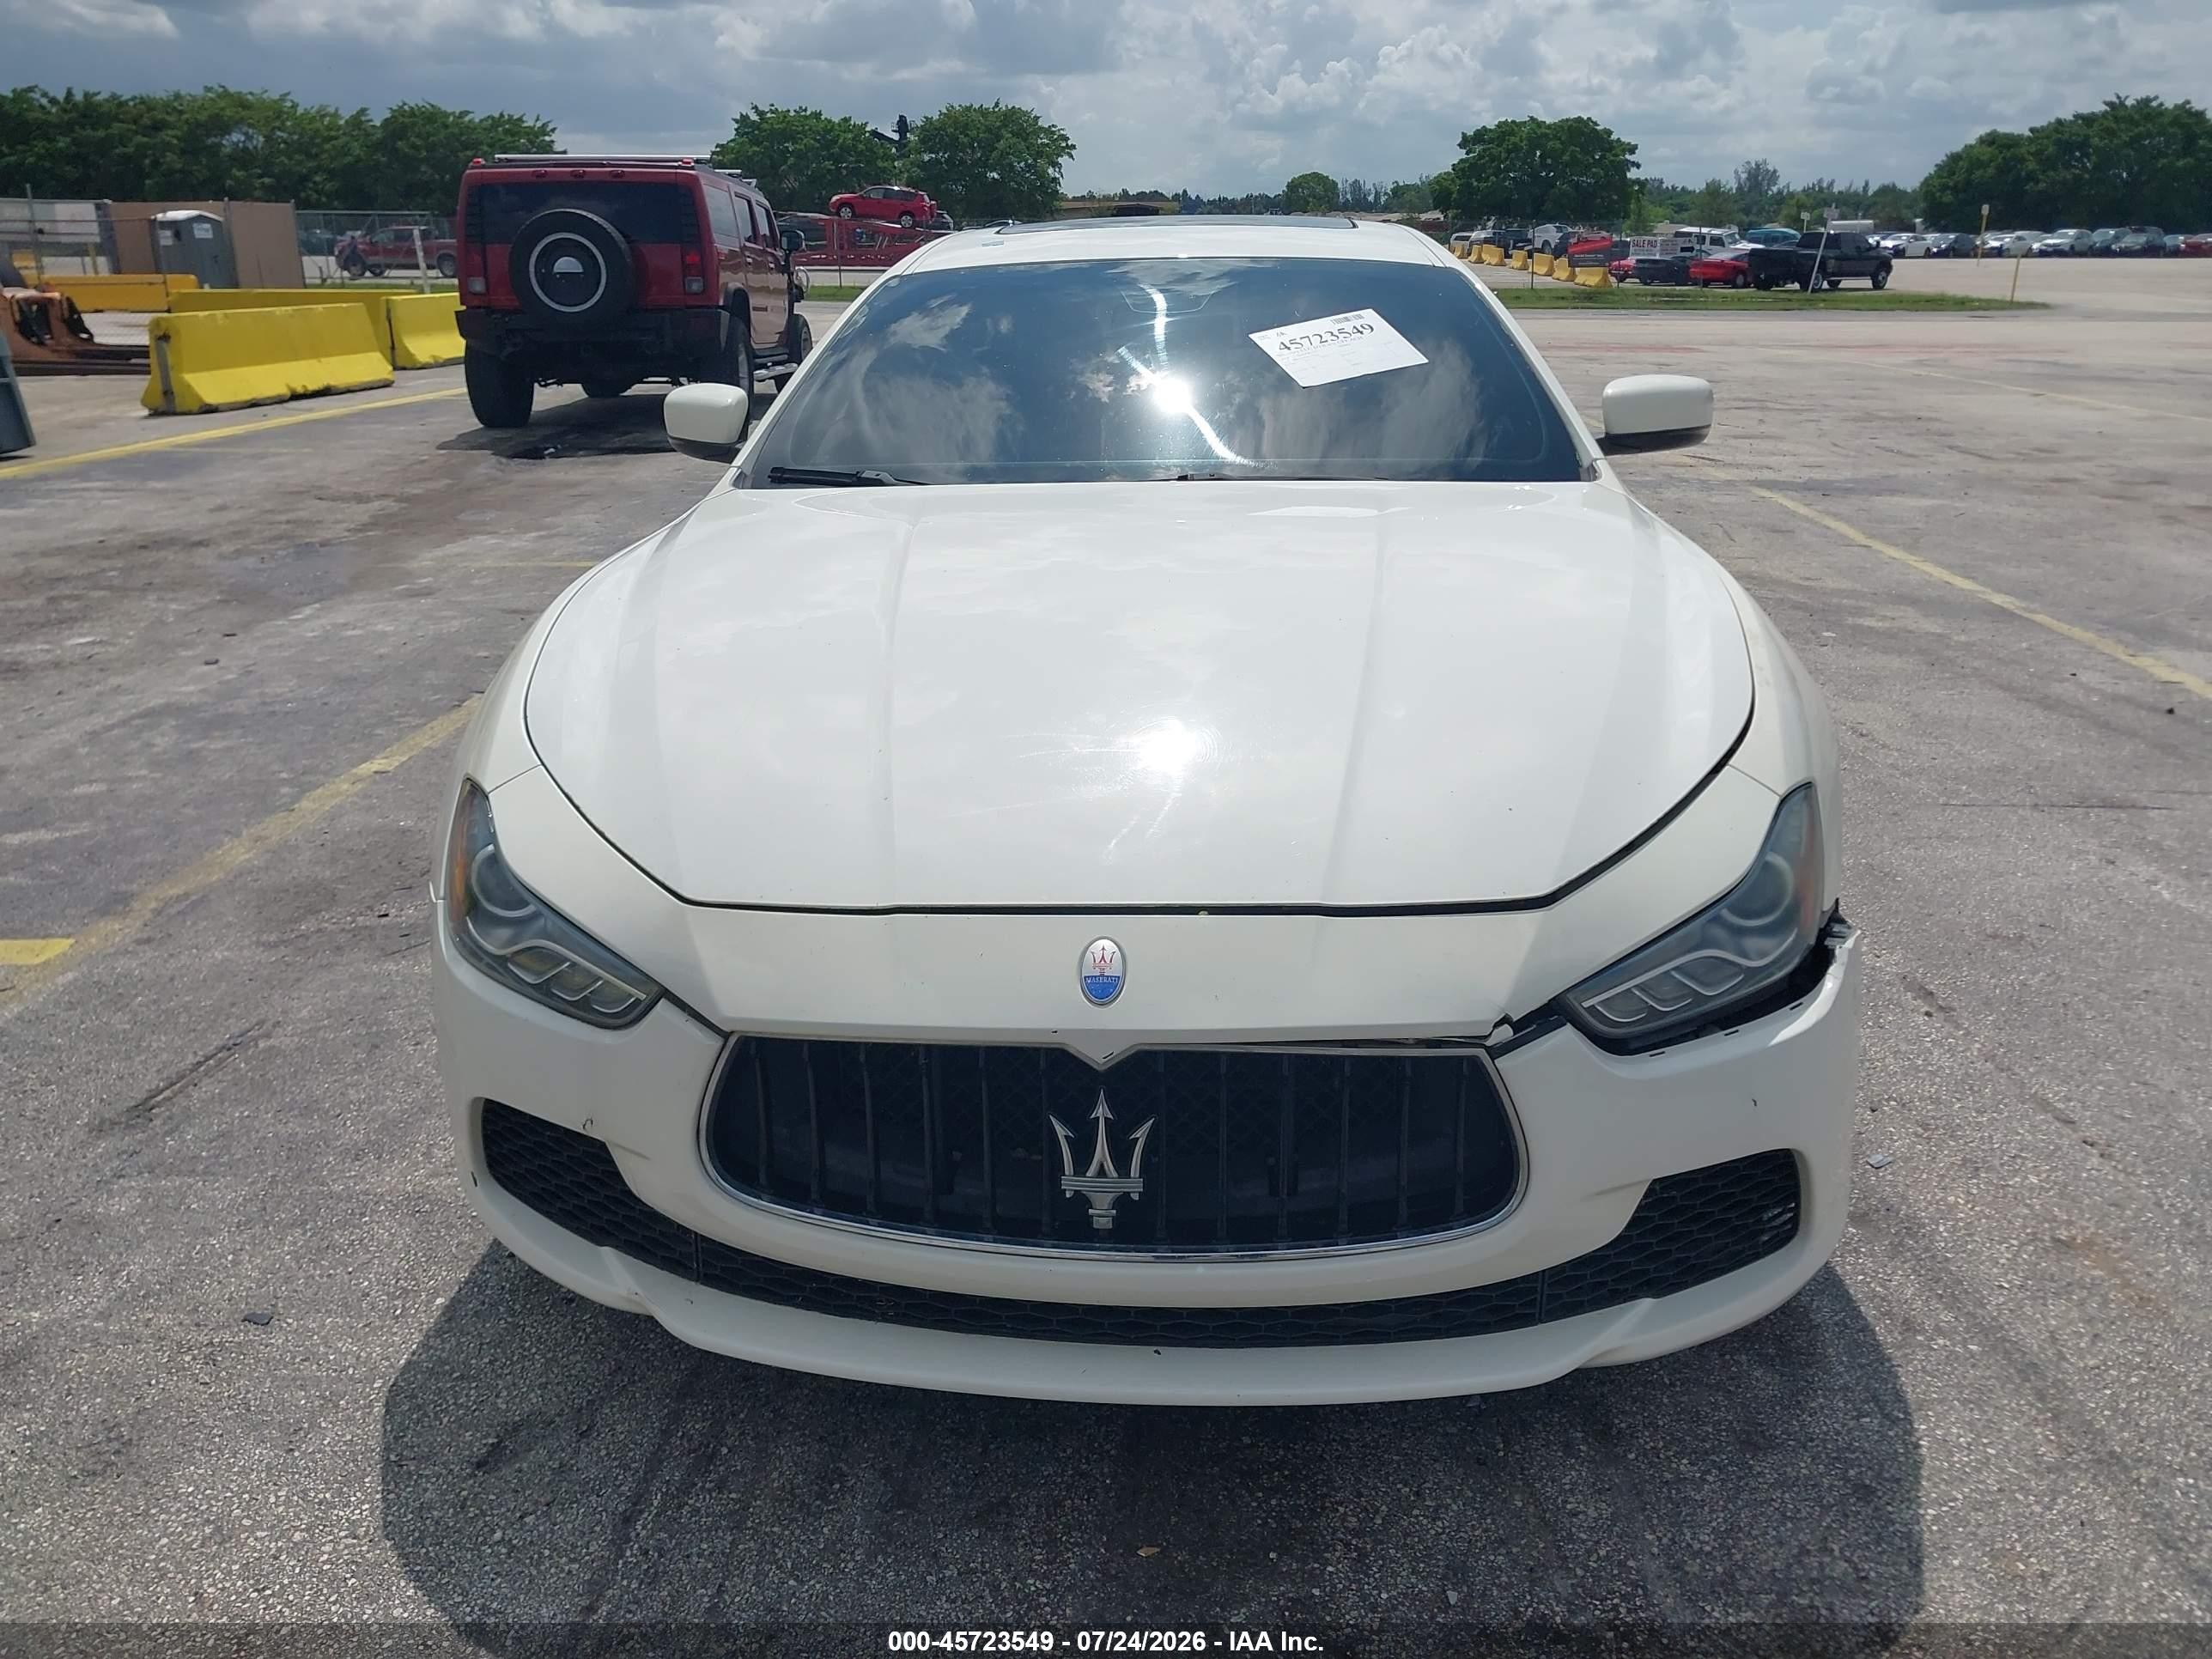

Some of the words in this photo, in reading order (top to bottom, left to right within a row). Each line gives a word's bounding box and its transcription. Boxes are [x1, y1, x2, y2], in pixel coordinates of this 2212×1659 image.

[1632, 239, 1646, 248] SALE
[1647, 239, 1657, 248] PAD
[1279, 323, 1374, 351] 45723549
